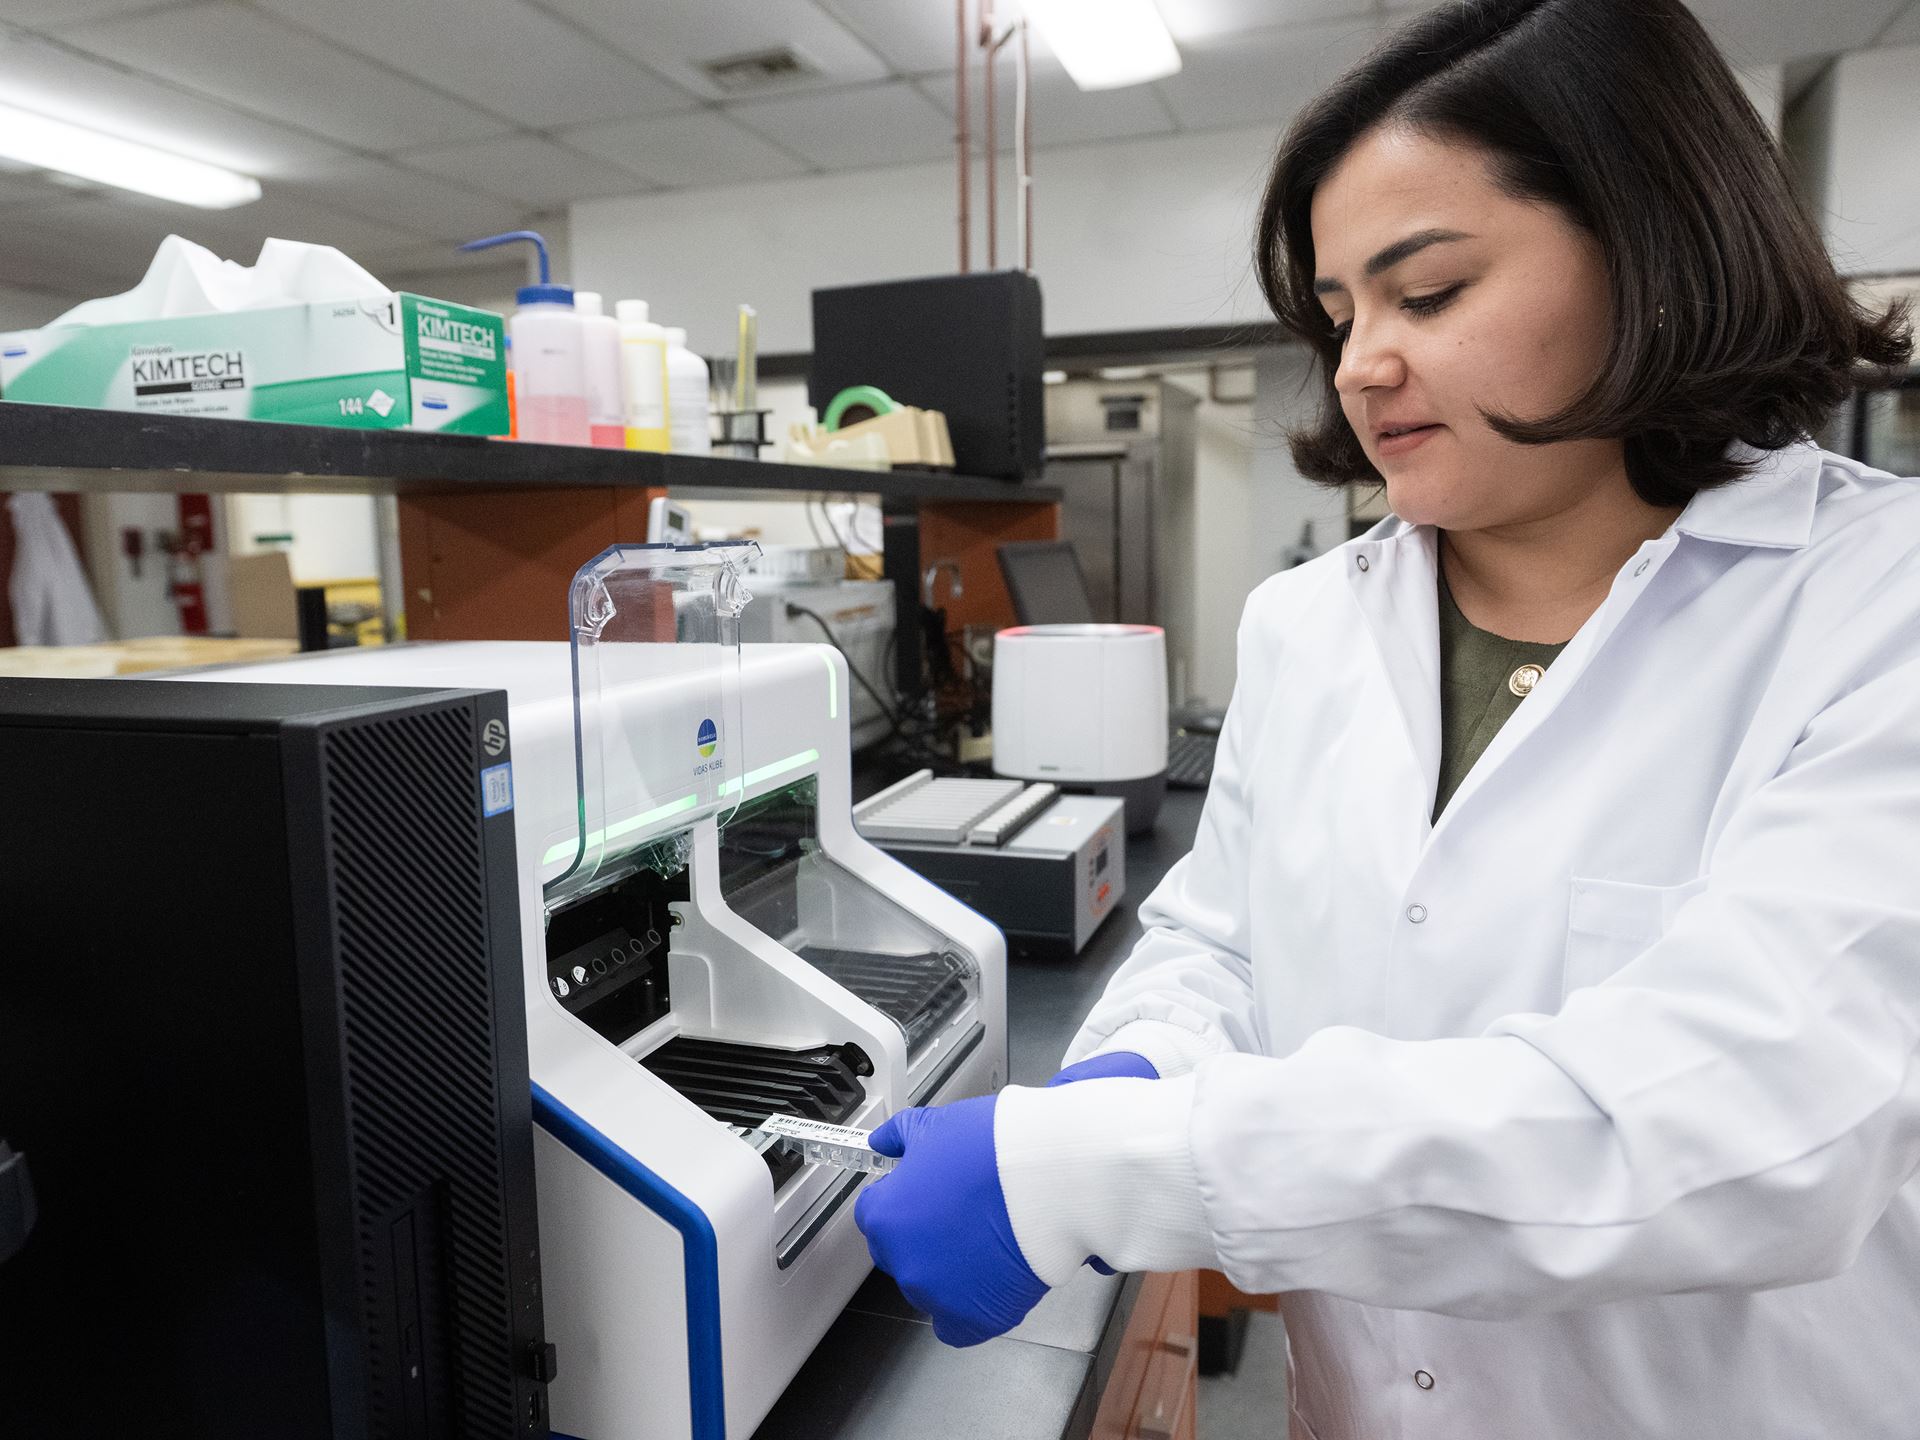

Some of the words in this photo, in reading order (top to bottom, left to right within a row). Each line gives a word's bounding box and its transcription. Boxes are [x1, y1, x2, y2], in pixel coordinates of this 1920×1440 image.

[417, 314, 495, 348] KIMTECH
[132, 351, 243, 382] KIMTECH
[338, 397, 364, 417] 144
[482, 722, 508, 751] hp
[708, 758, 723, 771] KUBE
